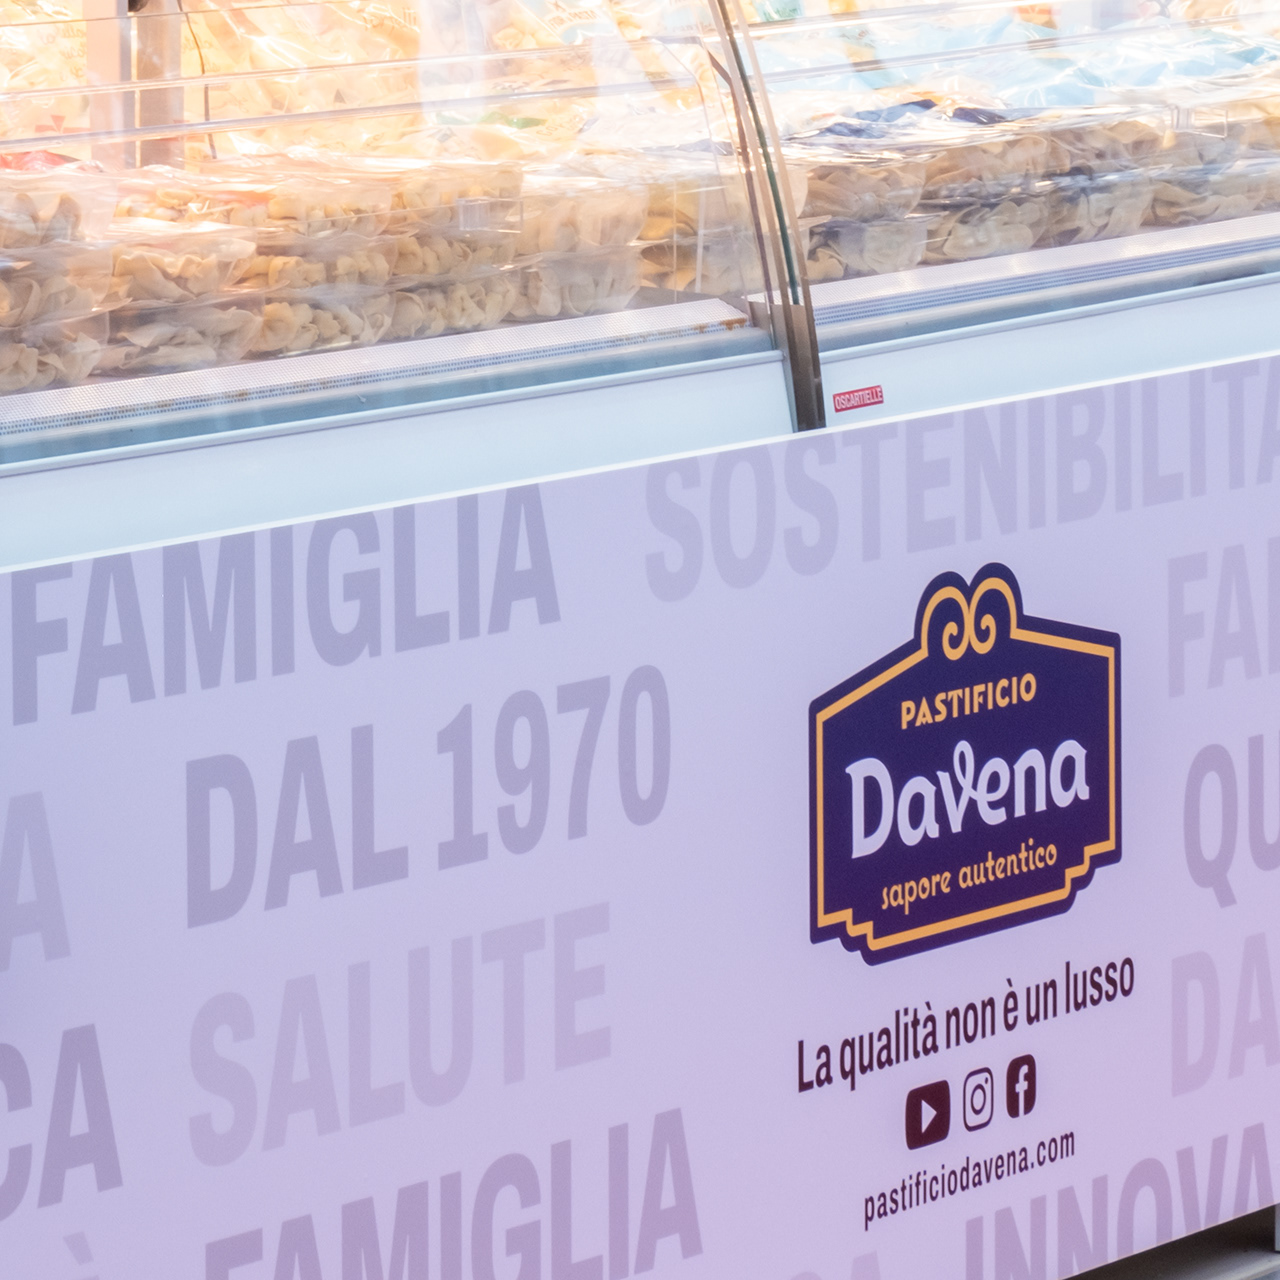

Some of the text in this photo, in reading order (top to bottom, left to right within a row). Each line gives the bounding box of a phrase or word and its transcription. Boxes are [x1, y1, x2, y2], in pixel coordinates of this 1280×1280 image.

[11, 482, 562, 727] FAMIGLIA
[901, 672, 1037, 730] PASTIFICIO
[186, 723, 410, 929] DAL
[436, 664, 671, 872] 1970
[844, 739, 1091, 859] Davena
[881, 837, 1058, 915] sapore autentico
[188, 901, 612, 1168] SALUTE
[797, 956, 1135, 1094] La qualità non è un lusso
[864, 1131, 1076, 1233] pastificiodavena.com
